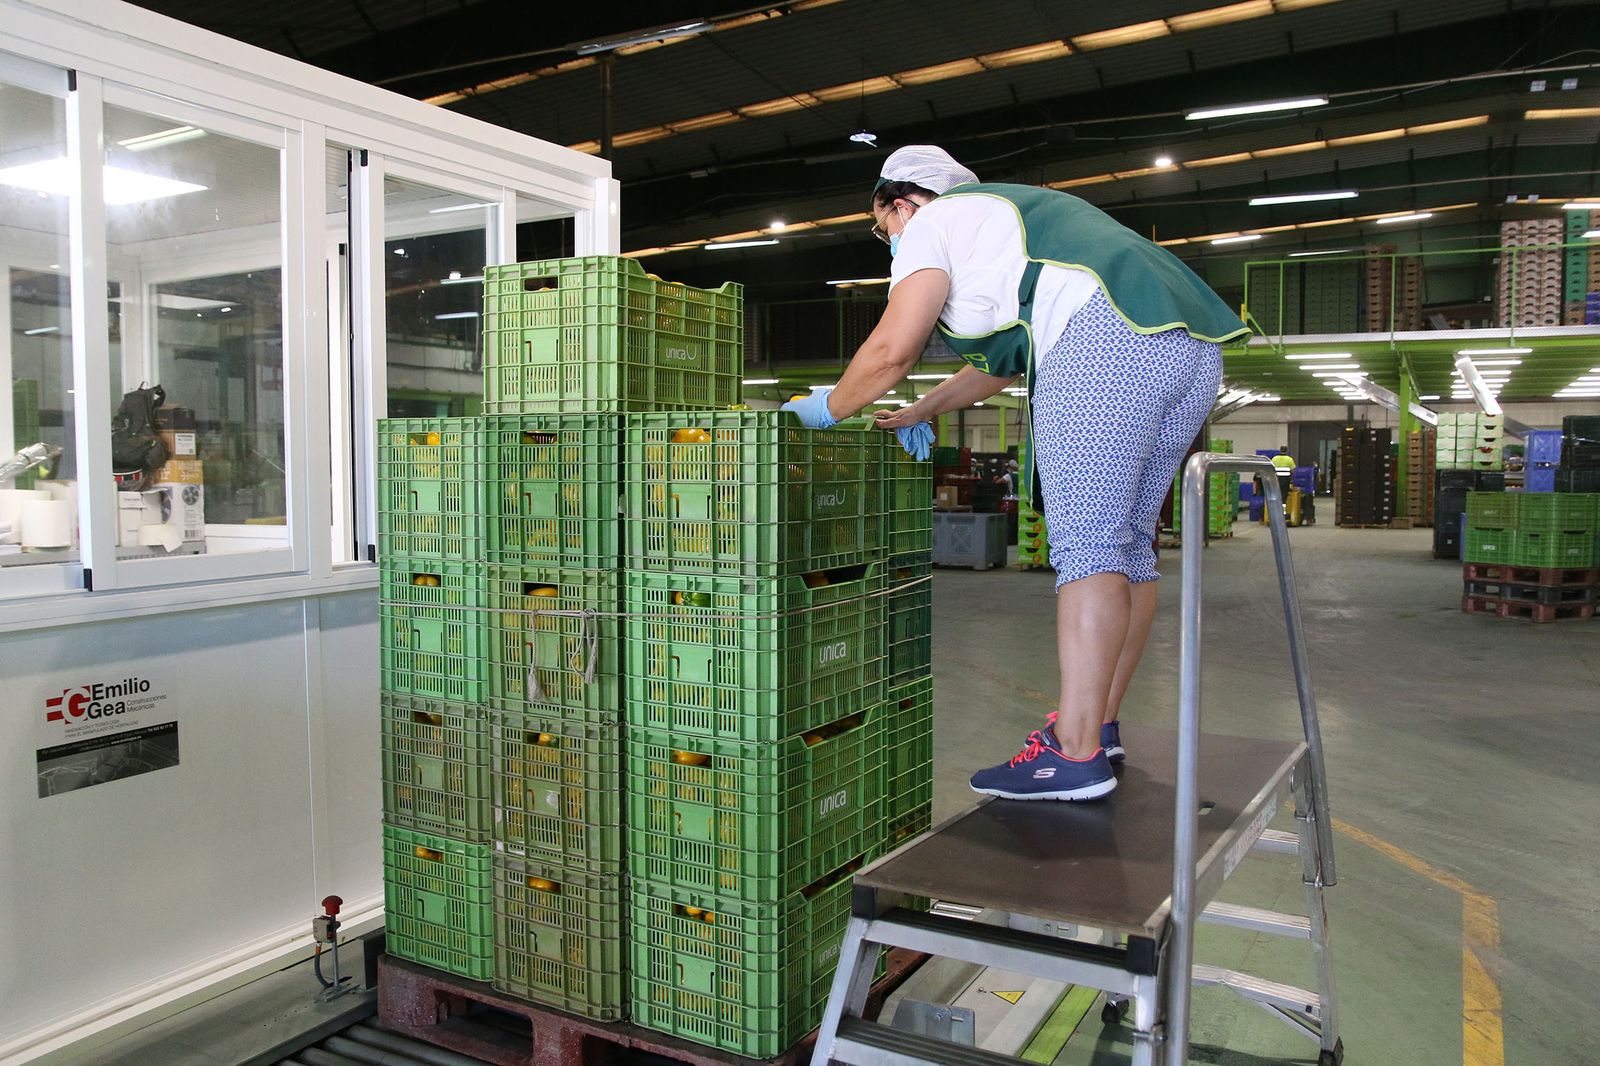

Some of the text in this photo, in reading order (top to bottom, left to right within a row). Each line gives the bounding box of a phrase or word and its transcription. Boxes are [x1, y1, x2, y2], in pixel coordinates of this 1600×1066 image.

[820, 641, 846, 664] unica
[92, 677, 150, 701] Emilio
[87, 701, 126, 719] Gea
[820, 790, 846, 815] unica
